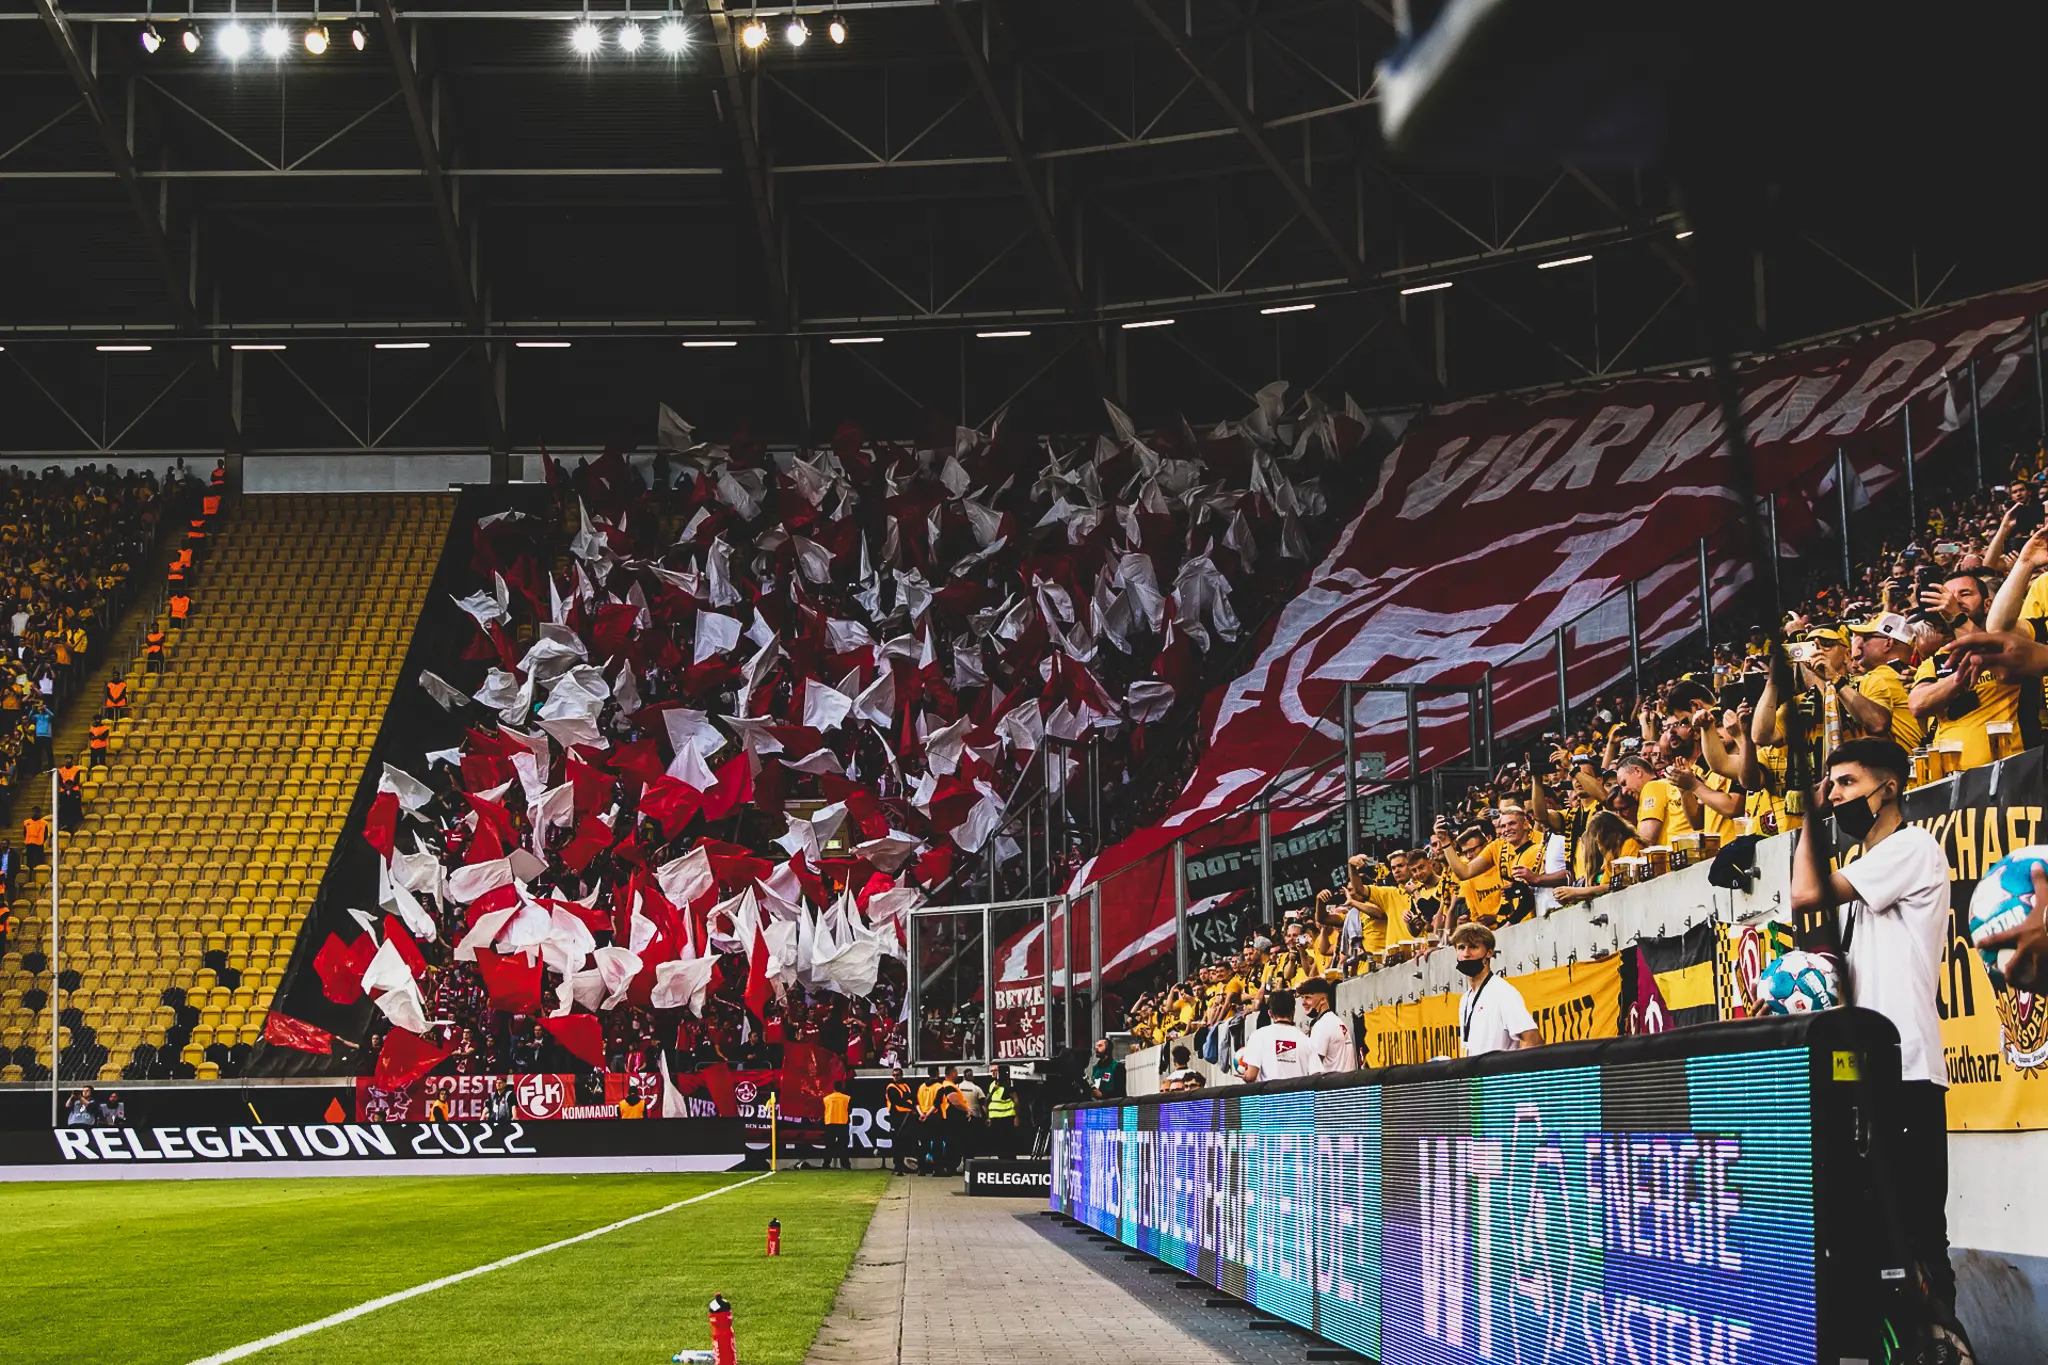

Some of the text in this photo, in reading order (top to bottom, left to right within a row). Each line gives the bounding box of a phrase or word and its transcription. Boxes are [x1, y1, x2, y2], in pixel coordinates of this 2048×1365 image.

[1274, 877, 1313, 906] FREI
[995, 985, 1045, 1010] BETZE
[2010, 993, 2046, 1048] DESDEN
[998, 1034, 1045, 1058] JUNGS
[425, 1075, 498, 1095] SOEST
[689, 1096, 717, 1118] WIR
[54, 1122, 537, 1160] RELEGATION 2022
[1586, 1138, 1742, 1271] ENERGIE
